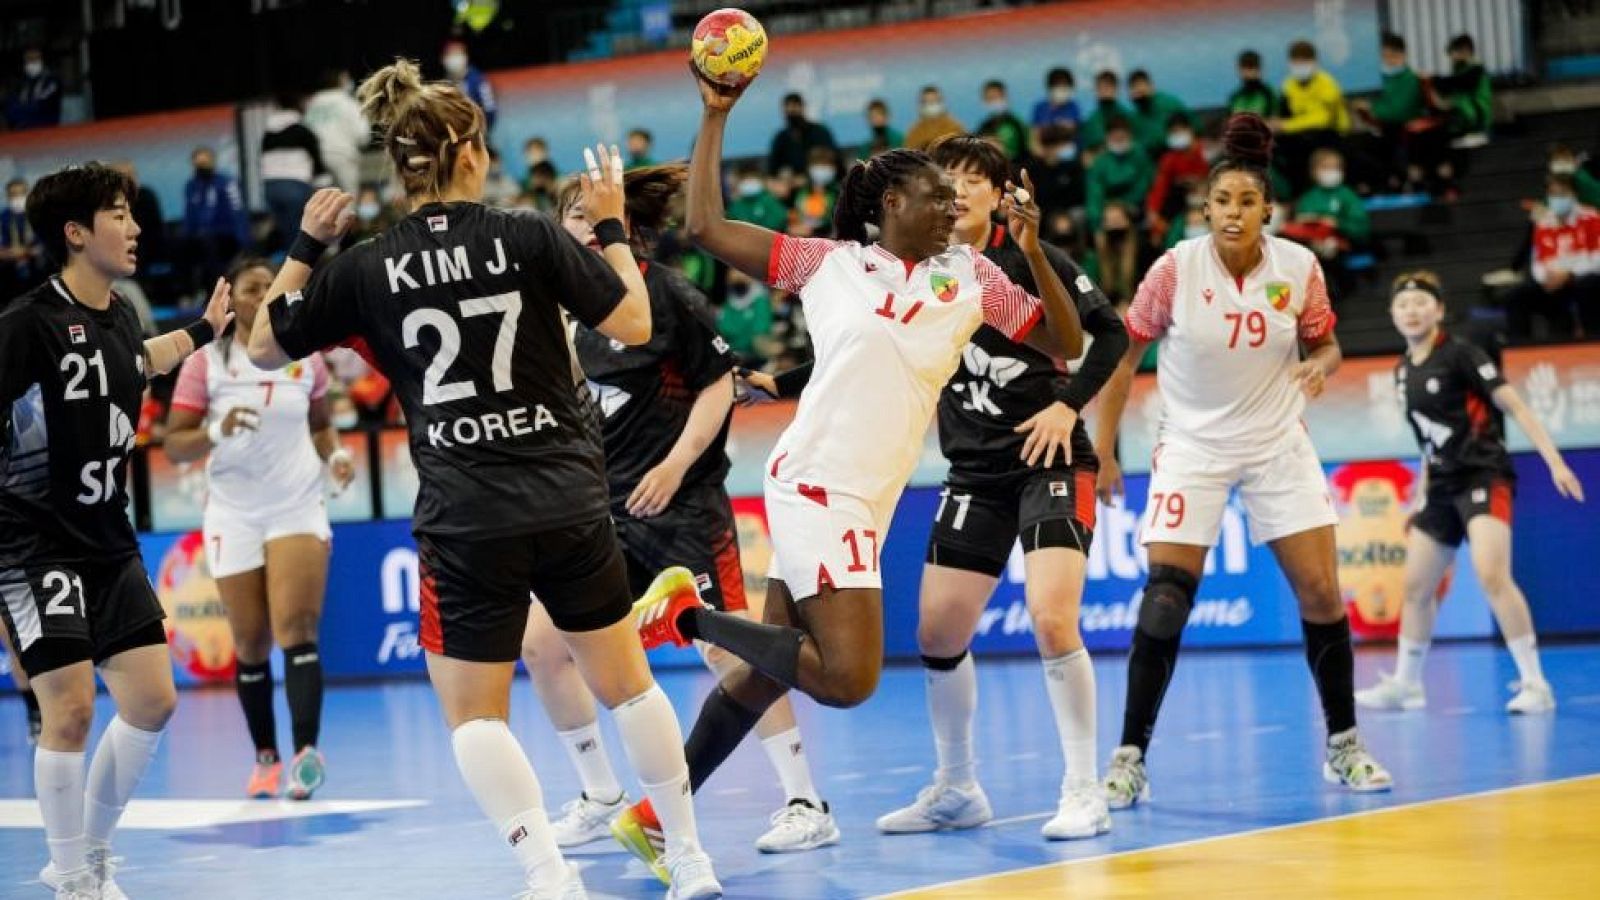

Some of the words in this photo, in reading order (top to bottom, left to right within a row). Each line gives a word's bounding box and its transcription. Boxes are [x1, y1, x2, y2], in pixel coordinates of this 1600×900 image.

[385, 245, 473, 294] KIM
[485, 238, 520, 275] J.
[402, 290, 522, 406] 27
[1224, 311, 1266, 349] 79
[60, 350, 108, 400] 21
[259, 382, 274, 407] 7
[427, 403, 559, 448] KOREA
[935, 488, 972, 530] 11
[1150, 492, 1185, 529] 79
[212, 535, 222, 565] 7
[842, 528, 877, 573] 17
[42, 570, 86, 618] 21
[378, 621, 422, 662] Fo
